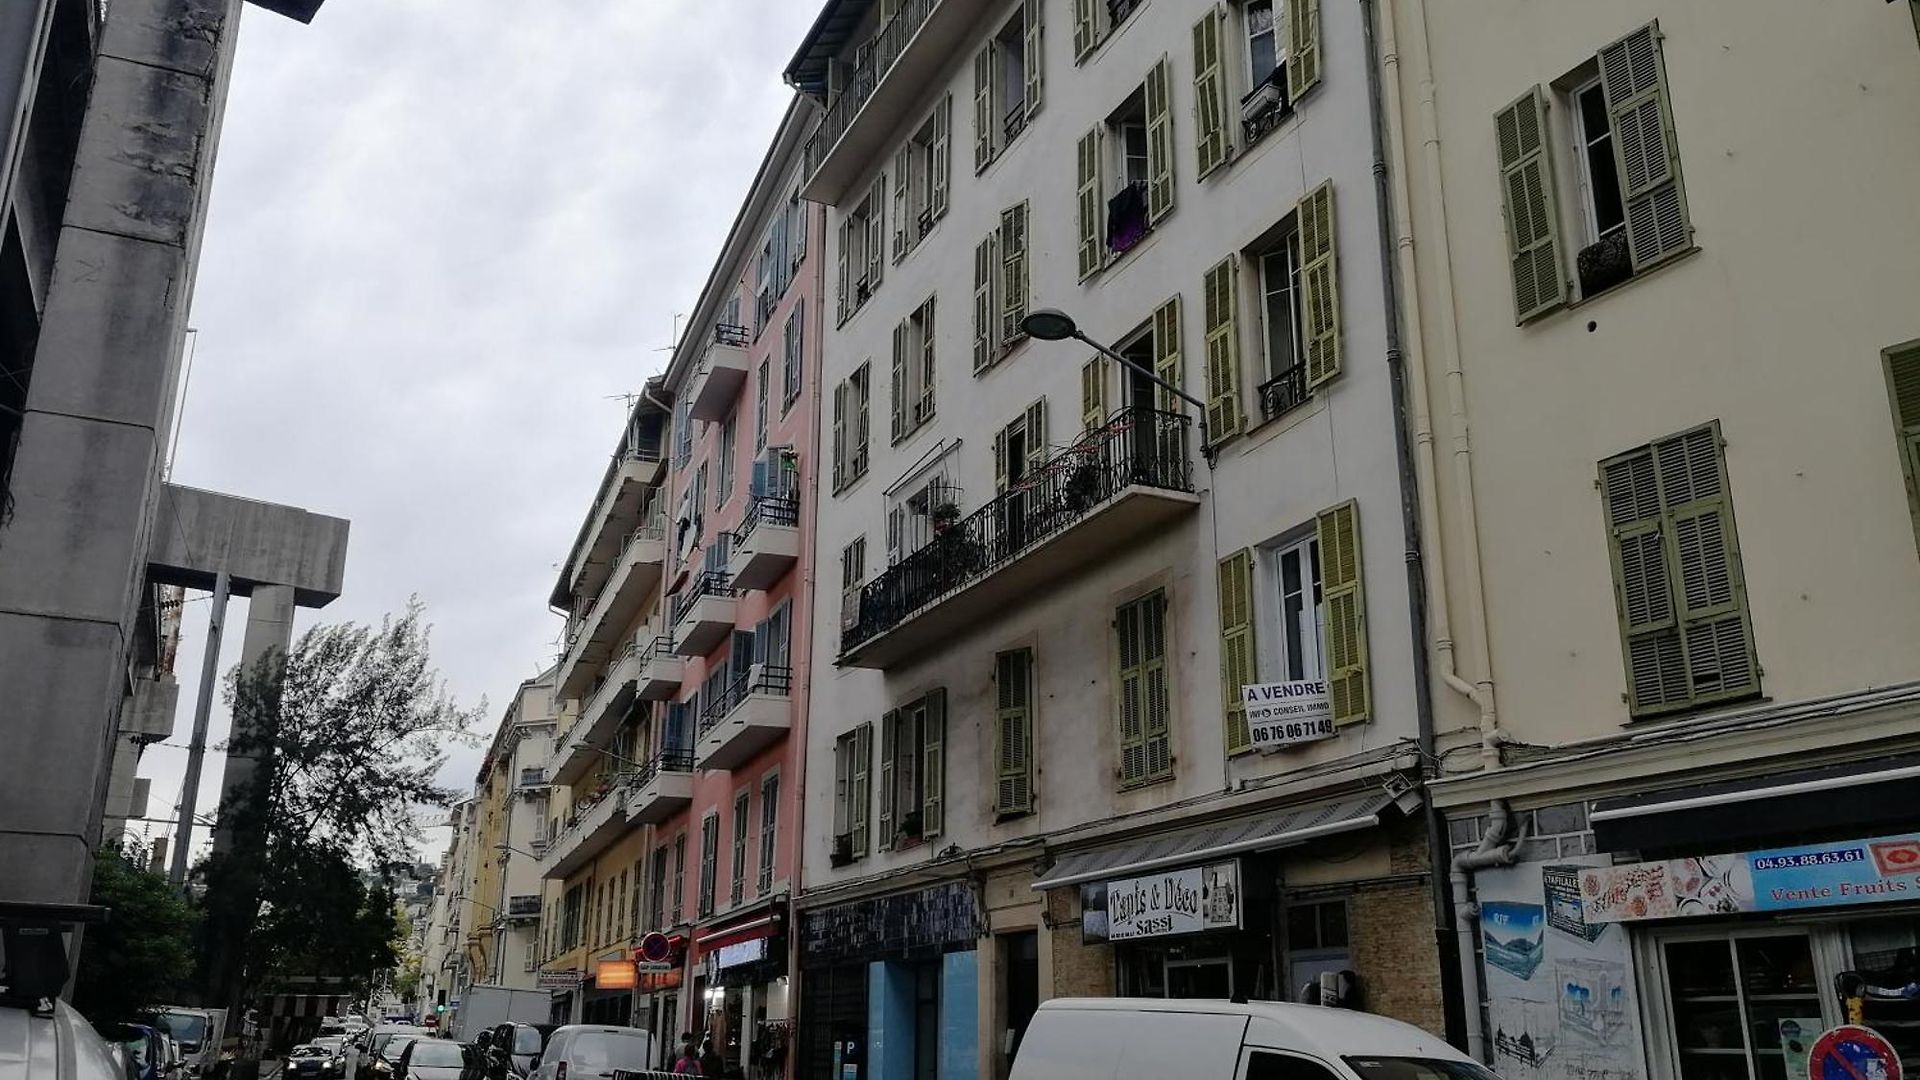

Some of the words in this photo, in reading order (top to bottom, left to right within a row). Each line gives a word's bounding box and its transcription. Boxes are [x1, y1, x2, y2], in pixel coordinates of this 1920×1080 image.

[1248, 689, 1258, 701] A
[1261, 682, 1326, 700] VENDRE
[1273, 705, 1305, 716] CONSEIL
[1253, 727, 1269, 742] 06
[1270, 725, 1284, 740] 76
[1286, 723, 1302, 738] 06
[1303, 721, 1316, 736] 71
[1317, 719, 1332, 734] 49
[1757, 850, 1862, 869] 04.93.88.63.61
[1771, 886, 1831, 901] Vente
[1839, 879, 1907, 896] Fruits
[1110, 881, 1146, 925] Tapis
[1151, 884, 1160, 910] &
[1164, 877, 1198, 914] Déco
